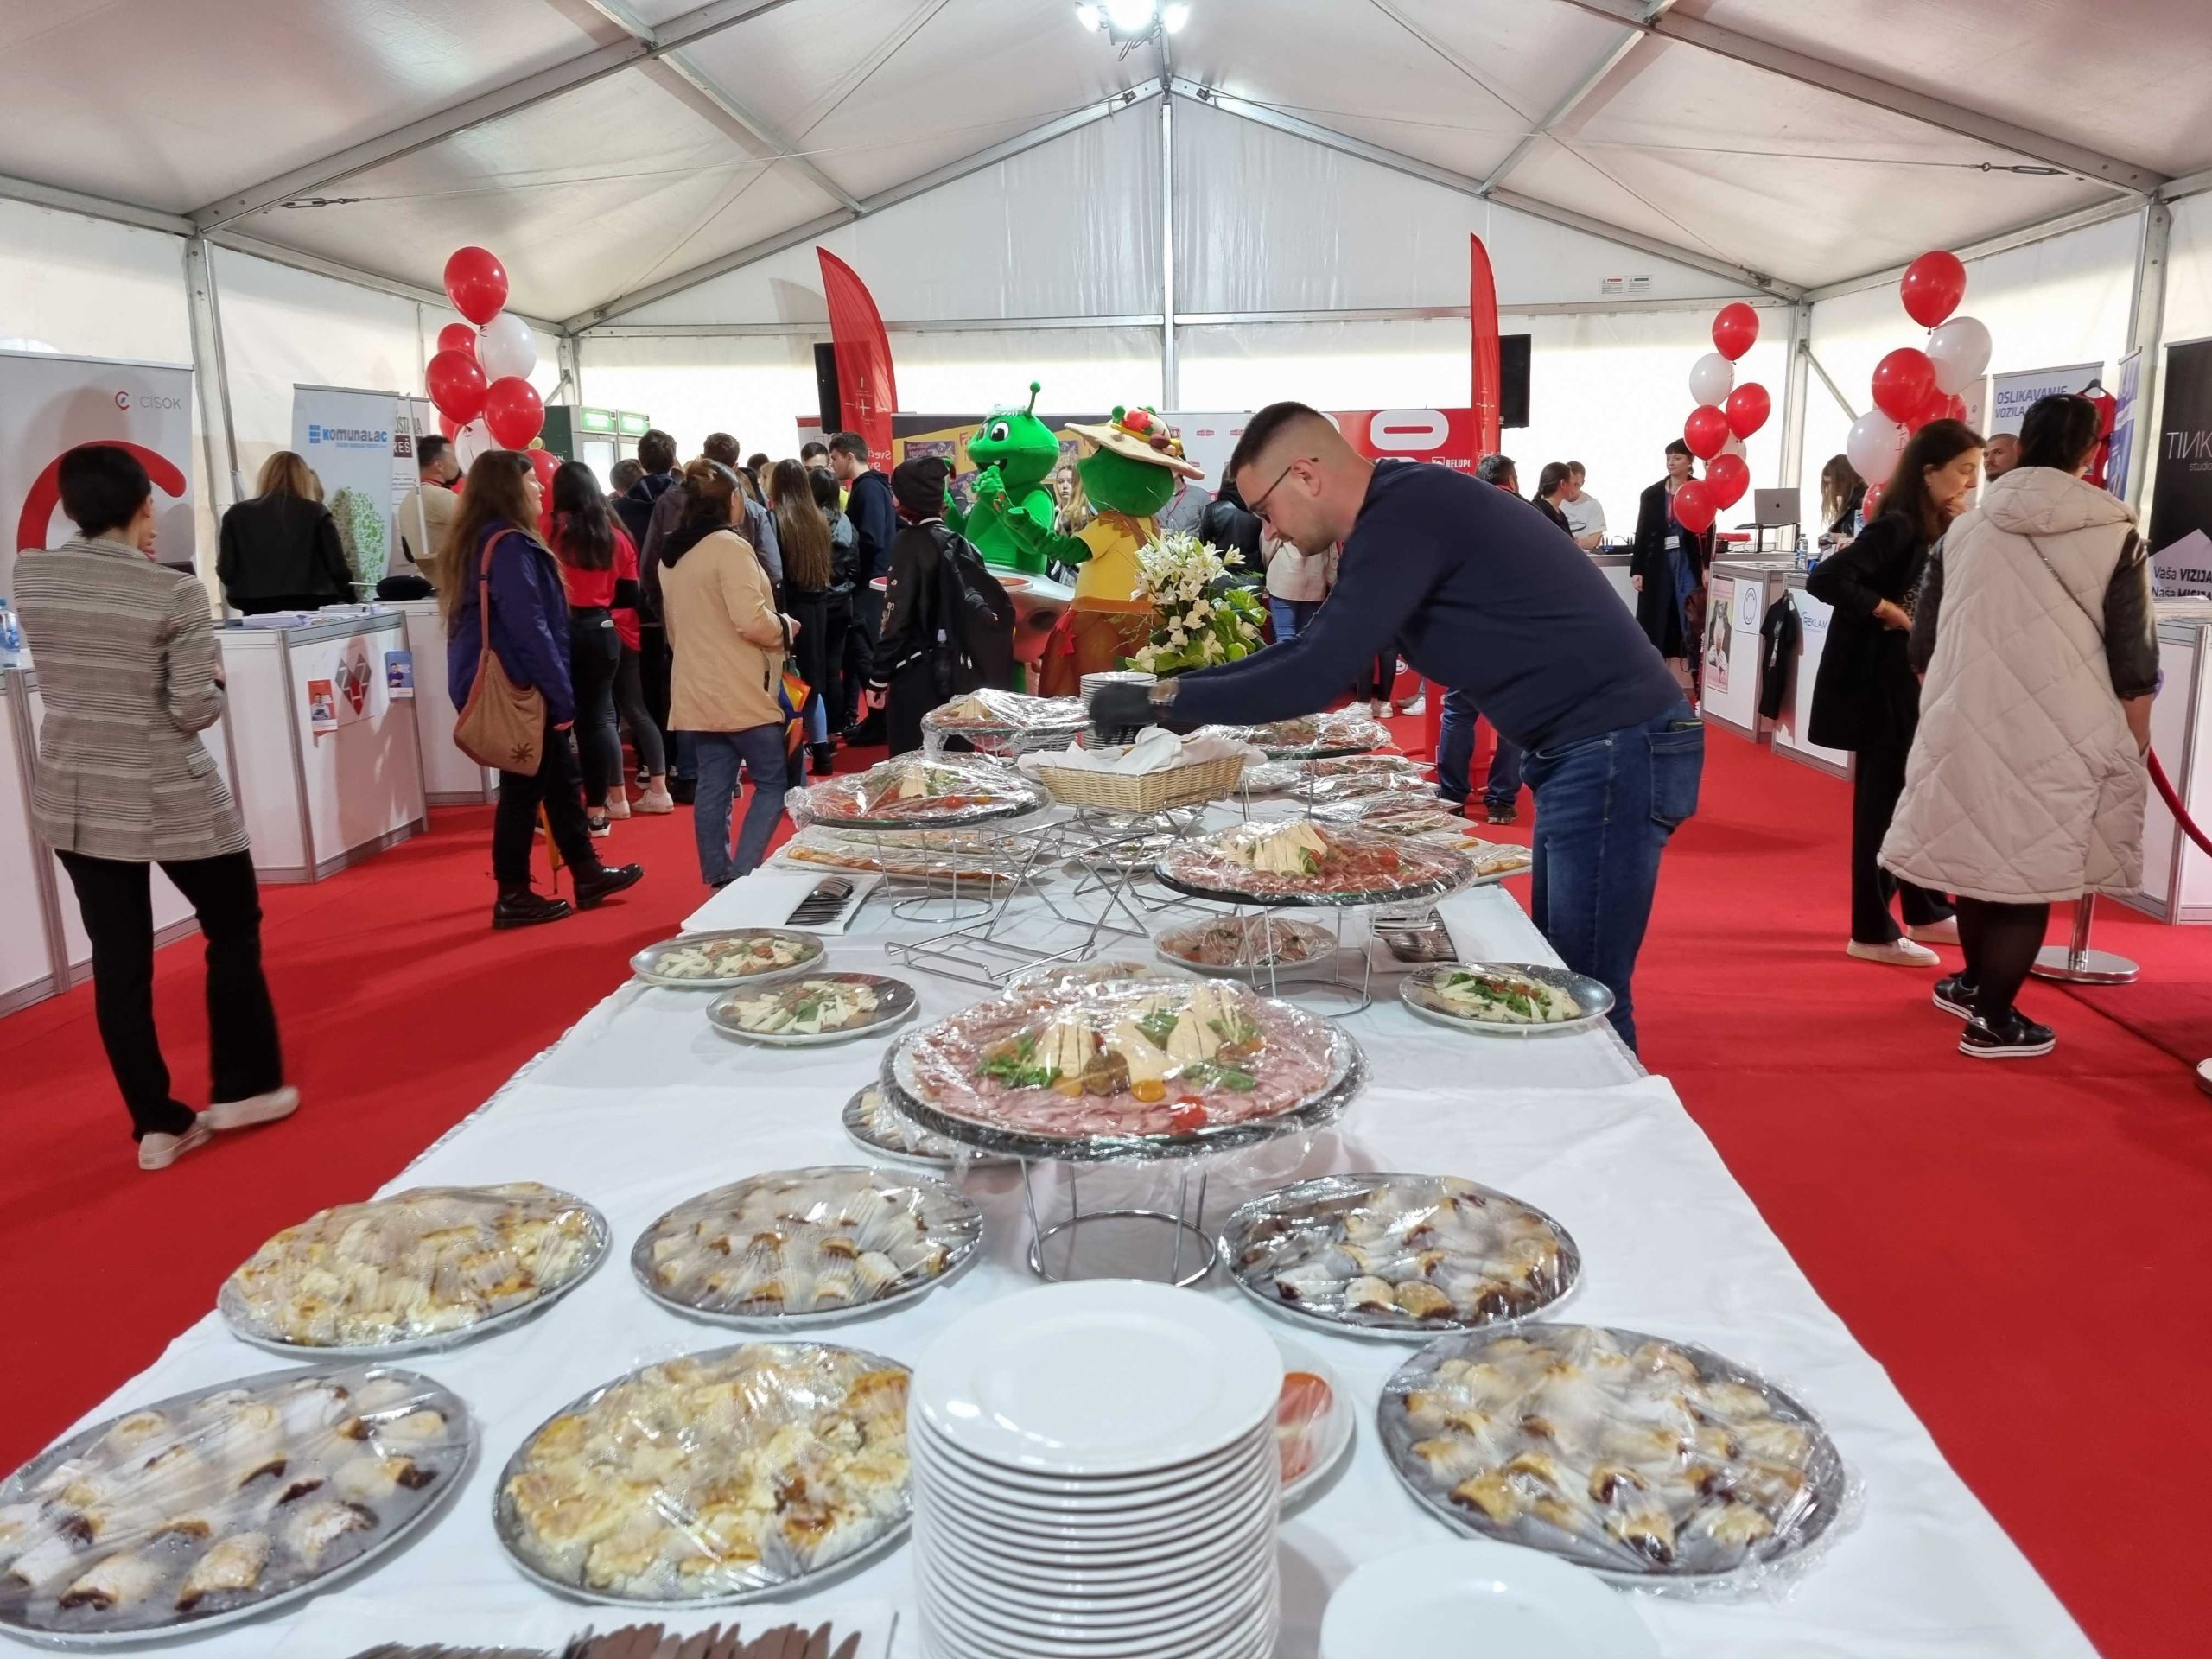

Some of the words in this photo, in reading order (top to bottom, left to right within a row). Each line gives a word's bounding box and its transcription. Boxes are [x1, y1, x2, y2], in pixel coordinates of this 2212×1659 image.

[139, 396, 181, 410] CISOK
[1995, 406, 2025, 418] VOZILA
[2154, 567, 2177, 580] Vaša
[2180, 569, 2212, 584] VIZIJA
[2152, 587, 2175, 597] Naša
